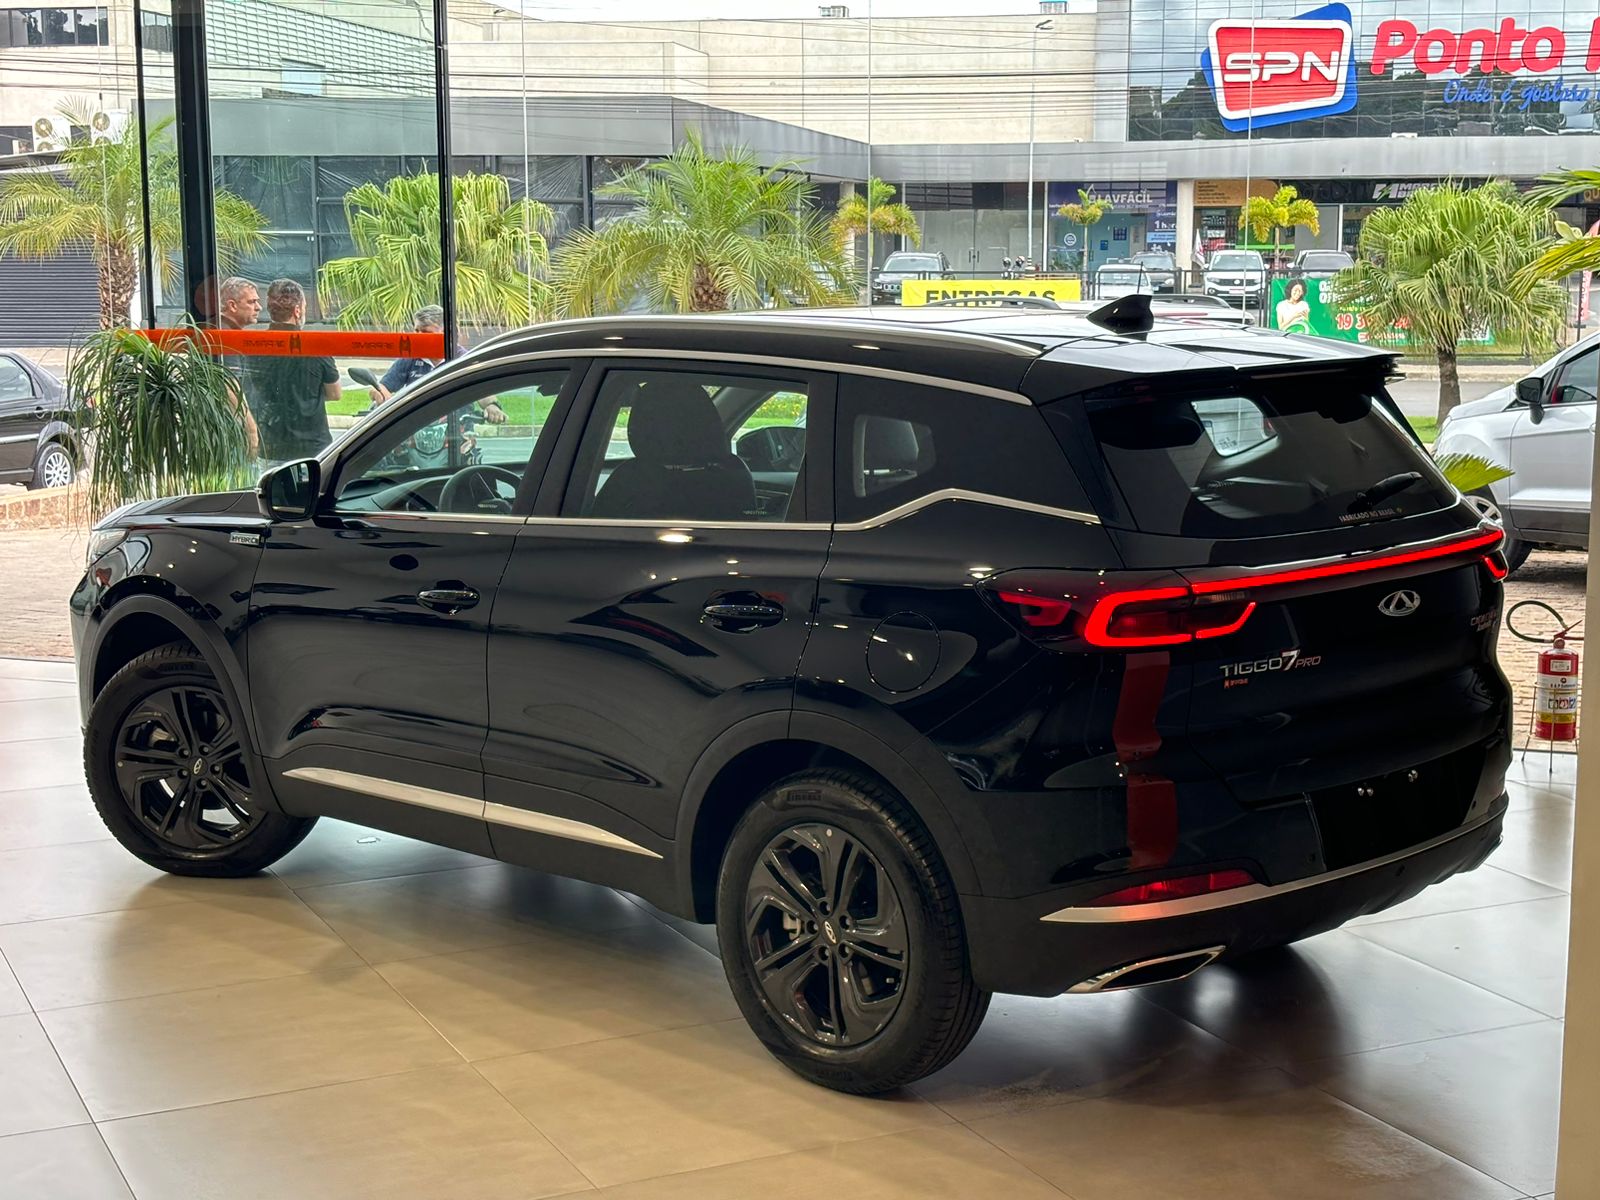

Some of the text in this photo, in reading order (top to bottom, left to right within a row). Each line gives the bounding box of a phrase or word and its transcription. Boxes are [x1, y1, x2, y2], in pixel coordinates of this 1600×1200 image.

[1370, 17, 1566, 75] Ponto
[1223, 51, 1340, 83] SPN
[1443, 78, 1494, 104] Onde
[1219, 658, 1283, 677] TIGGO
[1295, 656, 1321, 668] PRO
